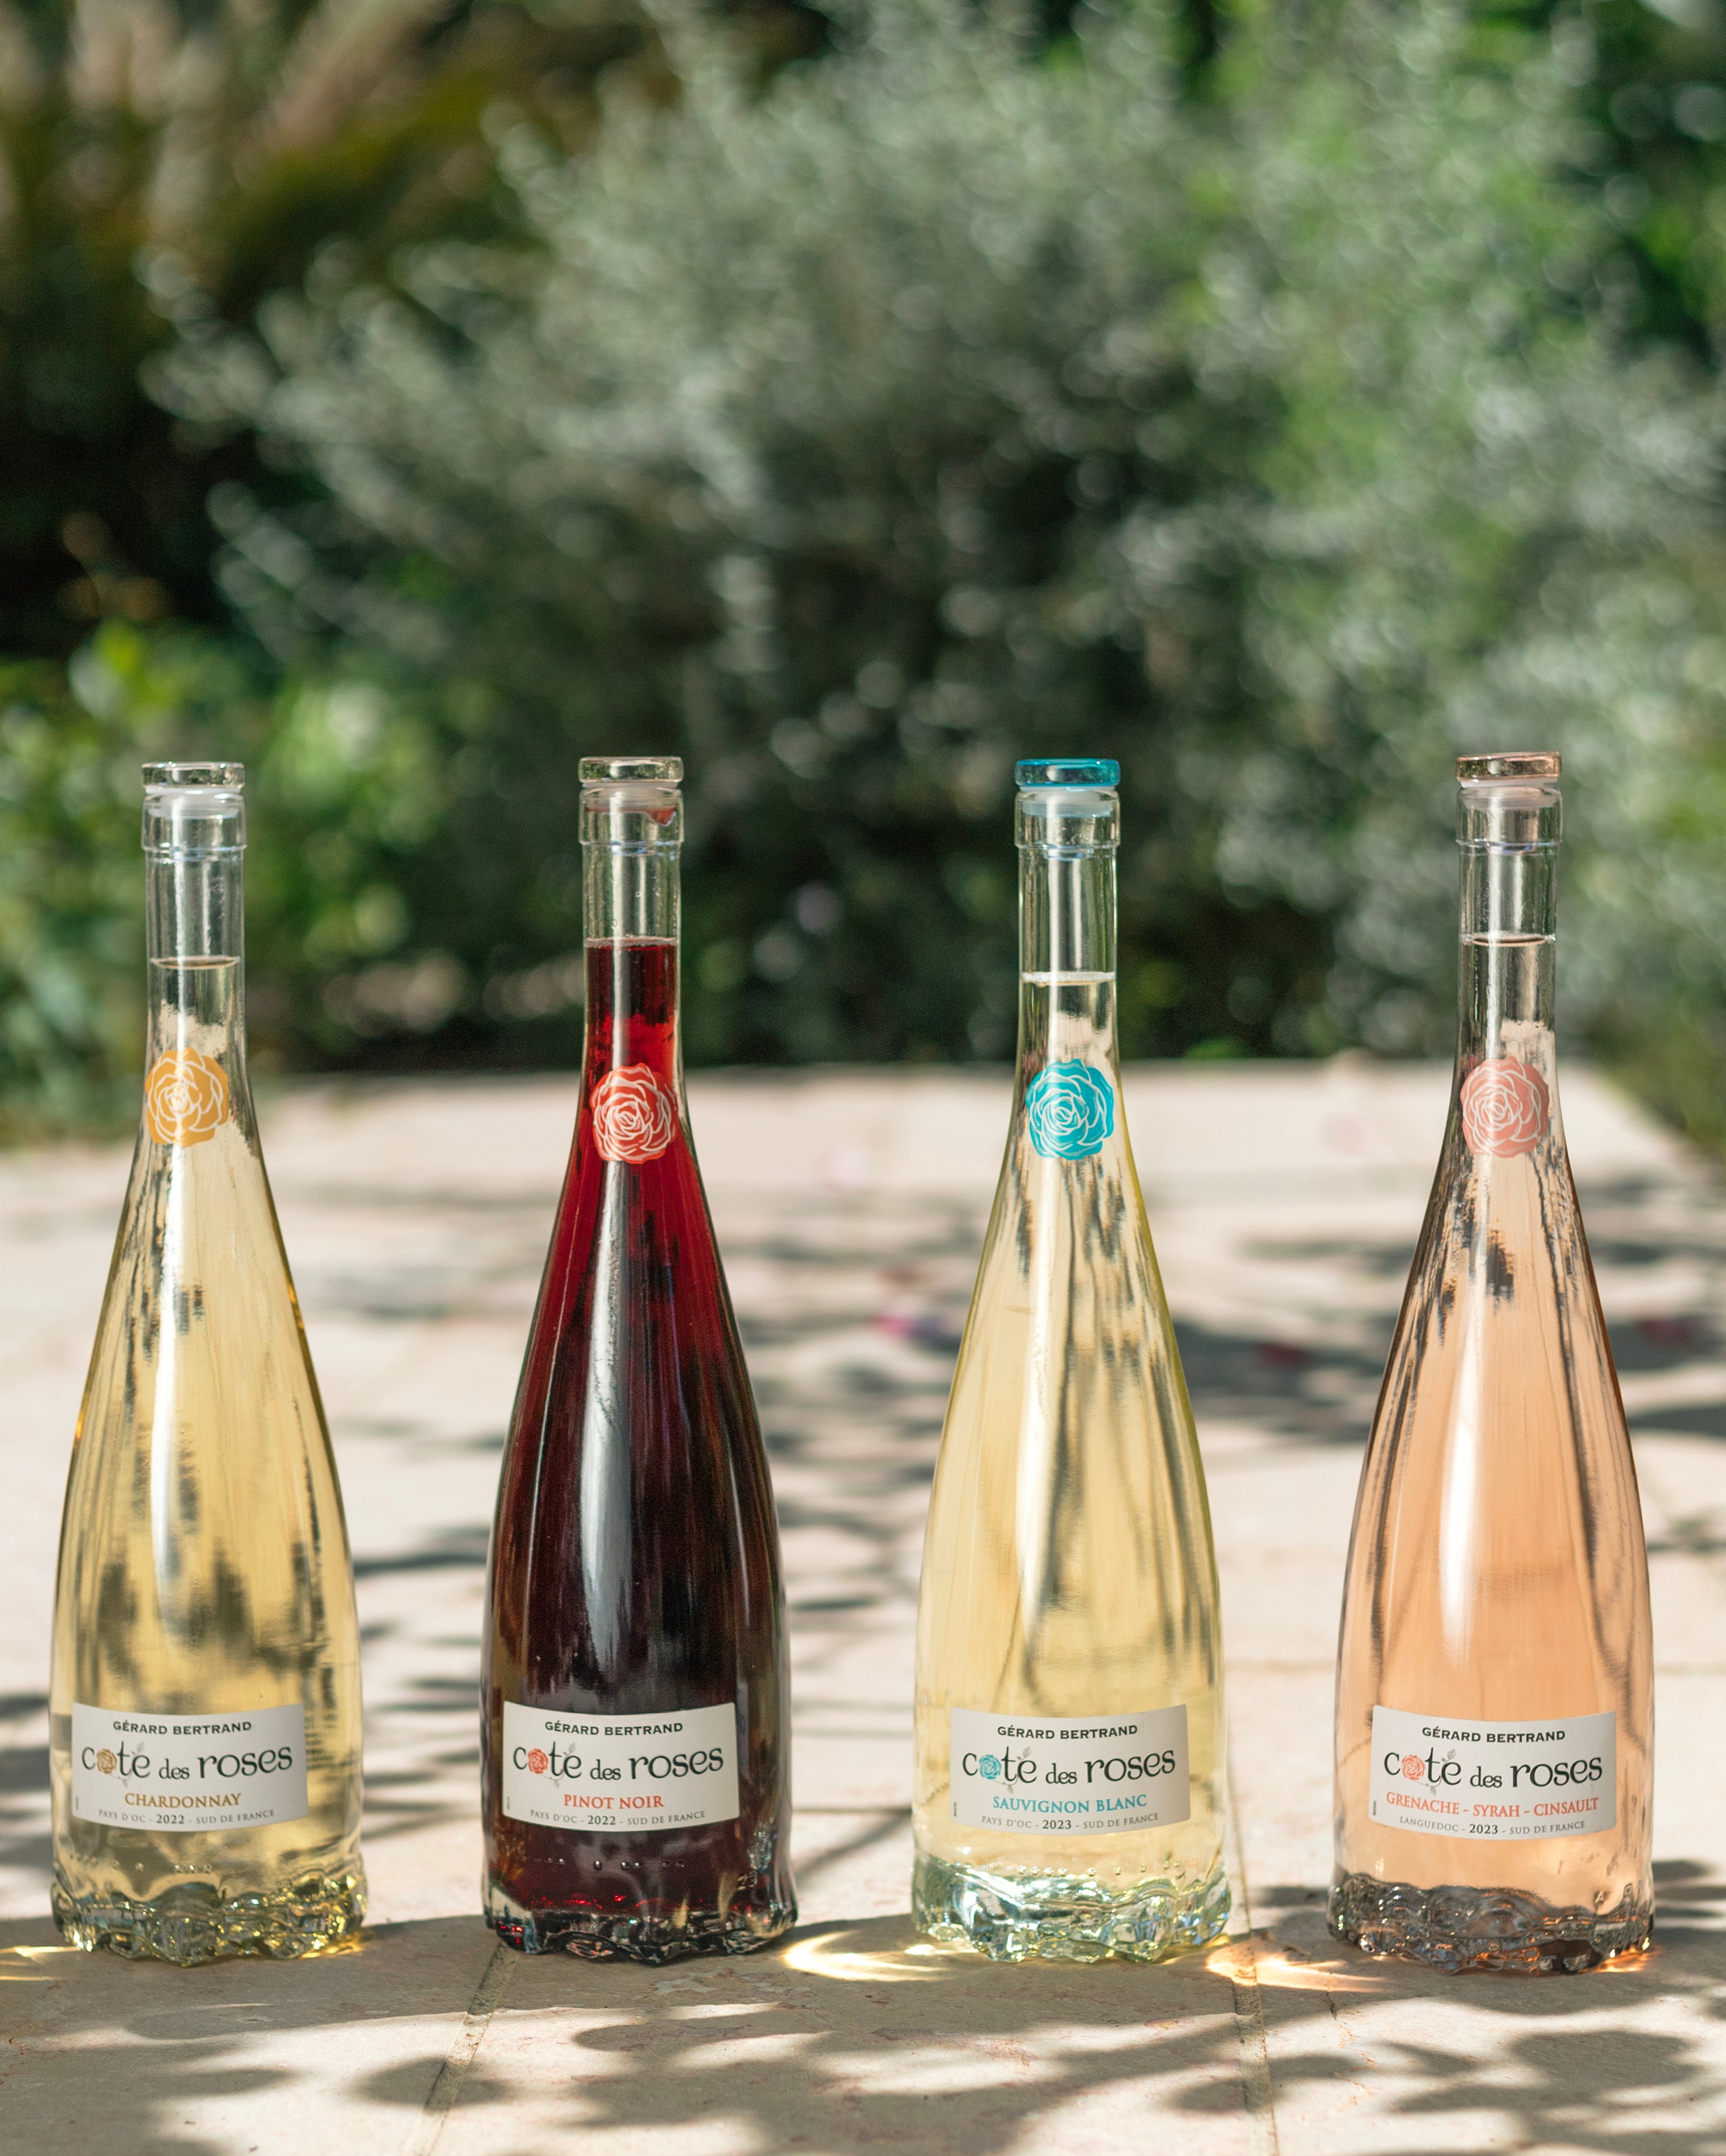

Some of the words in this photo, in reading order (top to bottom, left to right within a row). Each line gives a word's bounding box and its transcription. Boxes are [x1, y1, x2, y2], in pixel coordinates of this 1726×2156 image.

[112, 1720, 168, 1735] GÉRARD
[173, 1721, 252, 1735] BERTRAND
[545, 1720, 599, 1735] GÉRARD
[605, 1723, 683, 1736] BERTRAND
[997, 1724, 1055, 1739] GÉRARD
[1060, 1724, 1138, 1740] BERTRAND
[1422, 1726, 1481, 1742] GÉRARD
[1486, 1730, 1565, 1743] BERTRAND
[158, 1758, 190, 1780] des
[197, 1746, 293, 1779] roses
[590, 1758, 622, 1781] des
[629, 1747, 724, 1779] roses
[1045, 1762, 1077, 1785] des
[1084, 1750, 1176, 1783] roses
[1469, 1765, 1503, 1788] des
[1510, 1757, 1603, 1788] roses
[124, 1792, 242, 1809] CHARDONNAY
[564, 1794, 614, 1809] PINOT
[619, 1795, 665, 1809] NOIR
[993, 1796, 1090, 1813] SAUVIGNON
[1096, 1794, 1147, 1812] BLANC
[1386, 1790, 1459, 1815] GRENACHE
[1473, 1804, 1520, 1817] SYRAH
[1533, 1796, 1599, 1816] CINSAULT
[98, 1809, 118, 1819] PAYS
[121, 1813, 145, 1823] D'OC
[156, 1814, 185, 1824] 2022
[196, 1816, 217, 1824] SUD
[220, 1815, 233, 1823] DE
[236, 1809, 275, 1823] FRANCE
[530, 1809, 550, 1820] PAYS
[553, 1813, 577, 1824] D'OC
[588, 1815, 616, 1826] 2022
[627, 1817, 648, 1825] SUD
[651, 1816, 664, 1824] DE
[668, 1810, 705, 1823] FRANCE
[981, 1815, 1002, 1826] PAYS
[1006, 1819, 1032, 1829] D'OC
[1042, 1819, 1072, 1830] 2023
[1083, 1820, 1104, 1829] SUD
[1107, 1819, 1120, 1827] DE
[1123, 1812, 1159, 1826] FRANCE
[1399, 1816, 1459, 1833] LANGUEDOC
[1469, 1823, 1498, 1834] 2023
[1510, 1826, 1530, 1835] SUD
[1534, 1825, 1547, 1834] DE
[1550, 1820, 1585, 1833] FRANCE
